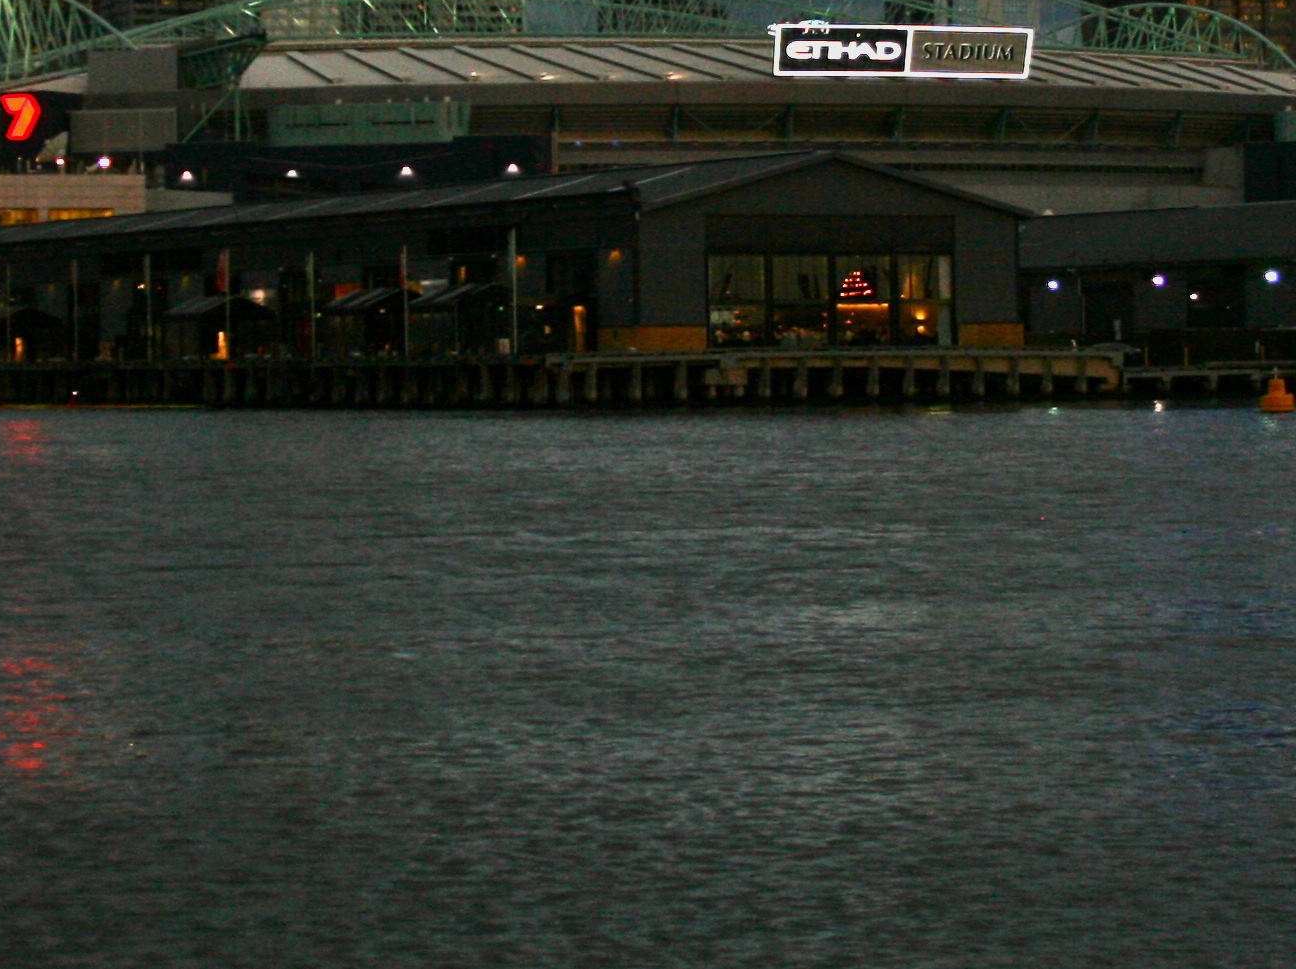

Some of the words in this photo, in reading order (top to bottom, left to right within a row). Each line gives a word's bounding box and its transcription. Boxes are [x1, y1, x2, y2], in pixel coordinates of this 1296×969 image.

[785, 40, 902, 62] ETIHAD
[922, 42, 1015, 62] STADIUM
[0, 93, 40, 140] 7
